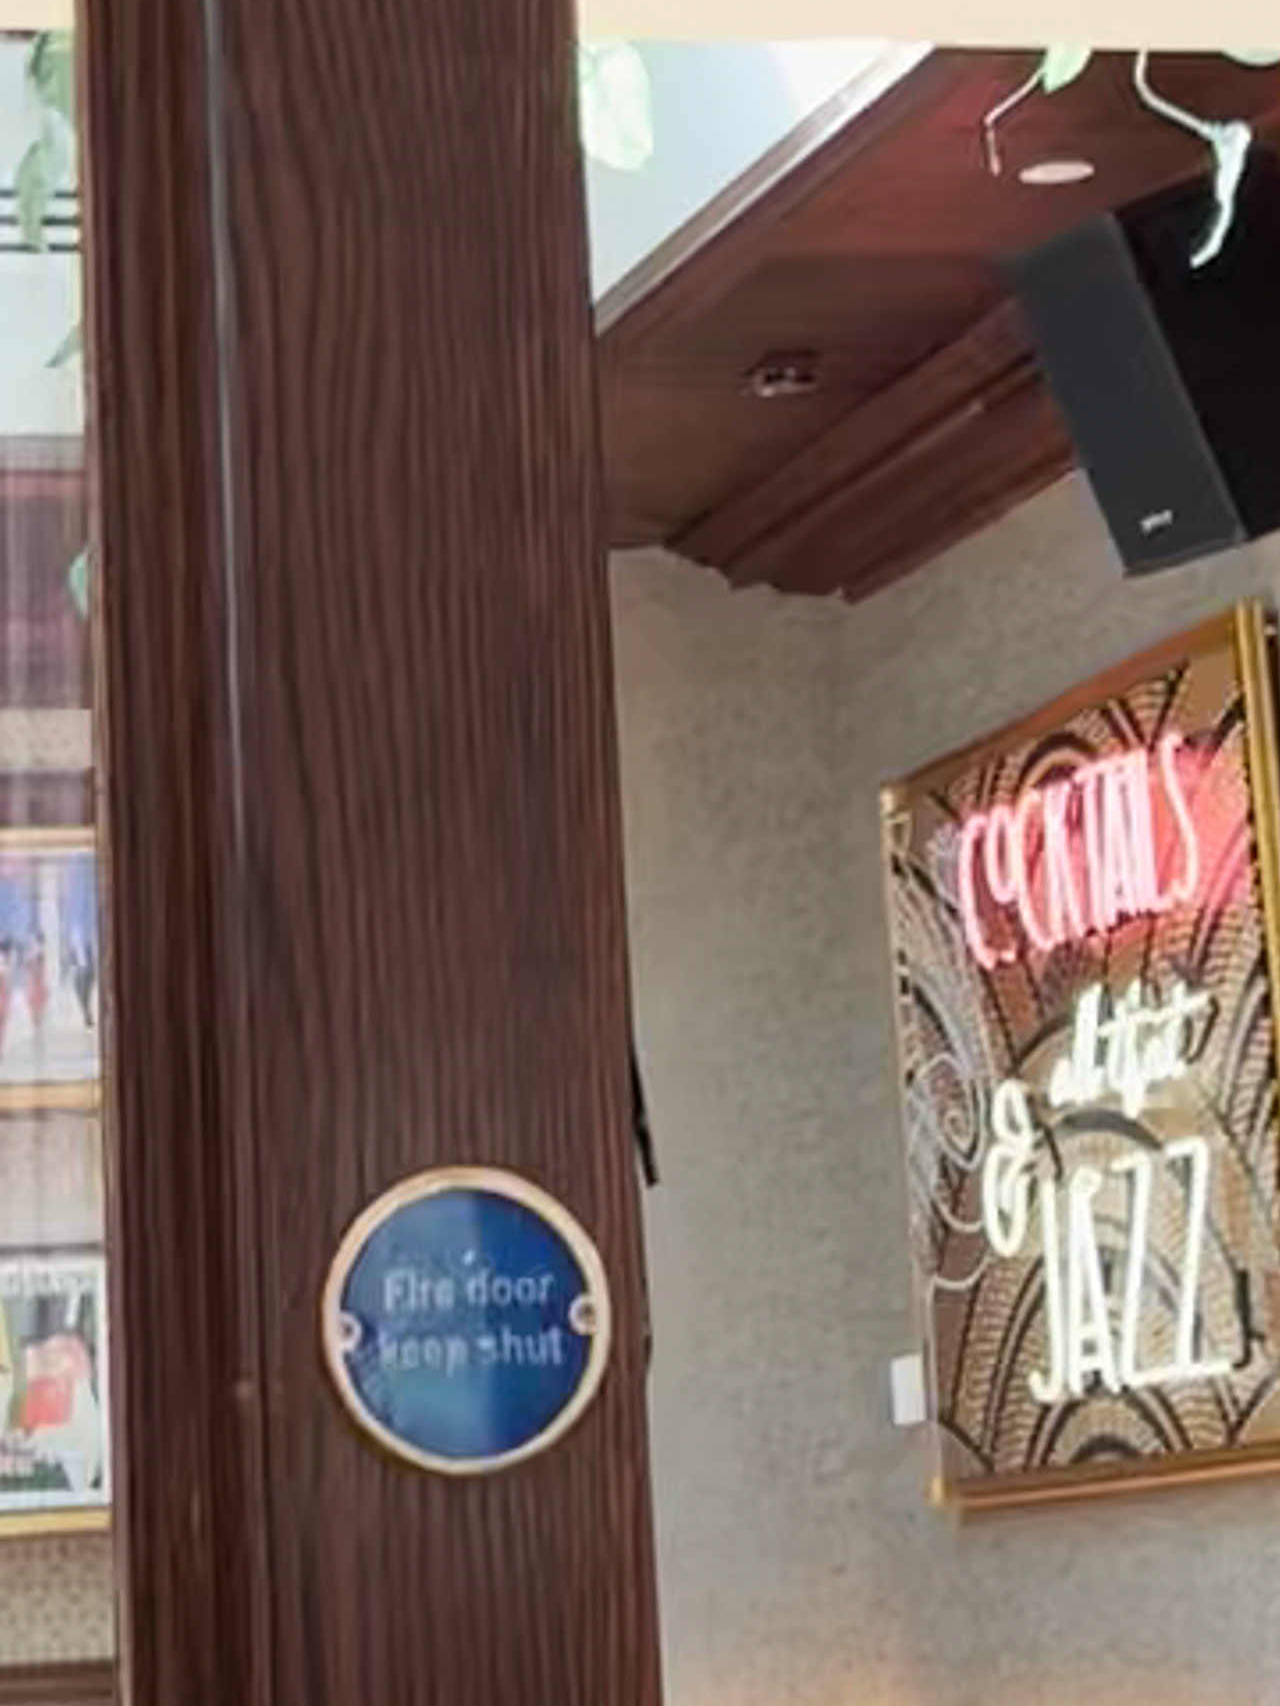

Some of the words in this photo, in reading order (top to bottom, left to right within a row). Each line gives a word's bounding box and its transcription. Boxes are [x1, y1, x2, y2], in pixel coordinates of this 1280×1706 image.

[958, 732, 1198, 970] COCKTAILS
[383, 1268, 455, 1313] Fire
[466, 1268, 555, 1306] door
[1028, 1136, 1232, 1404] JAZZ
[475, 1326, 565, 1366] shut
